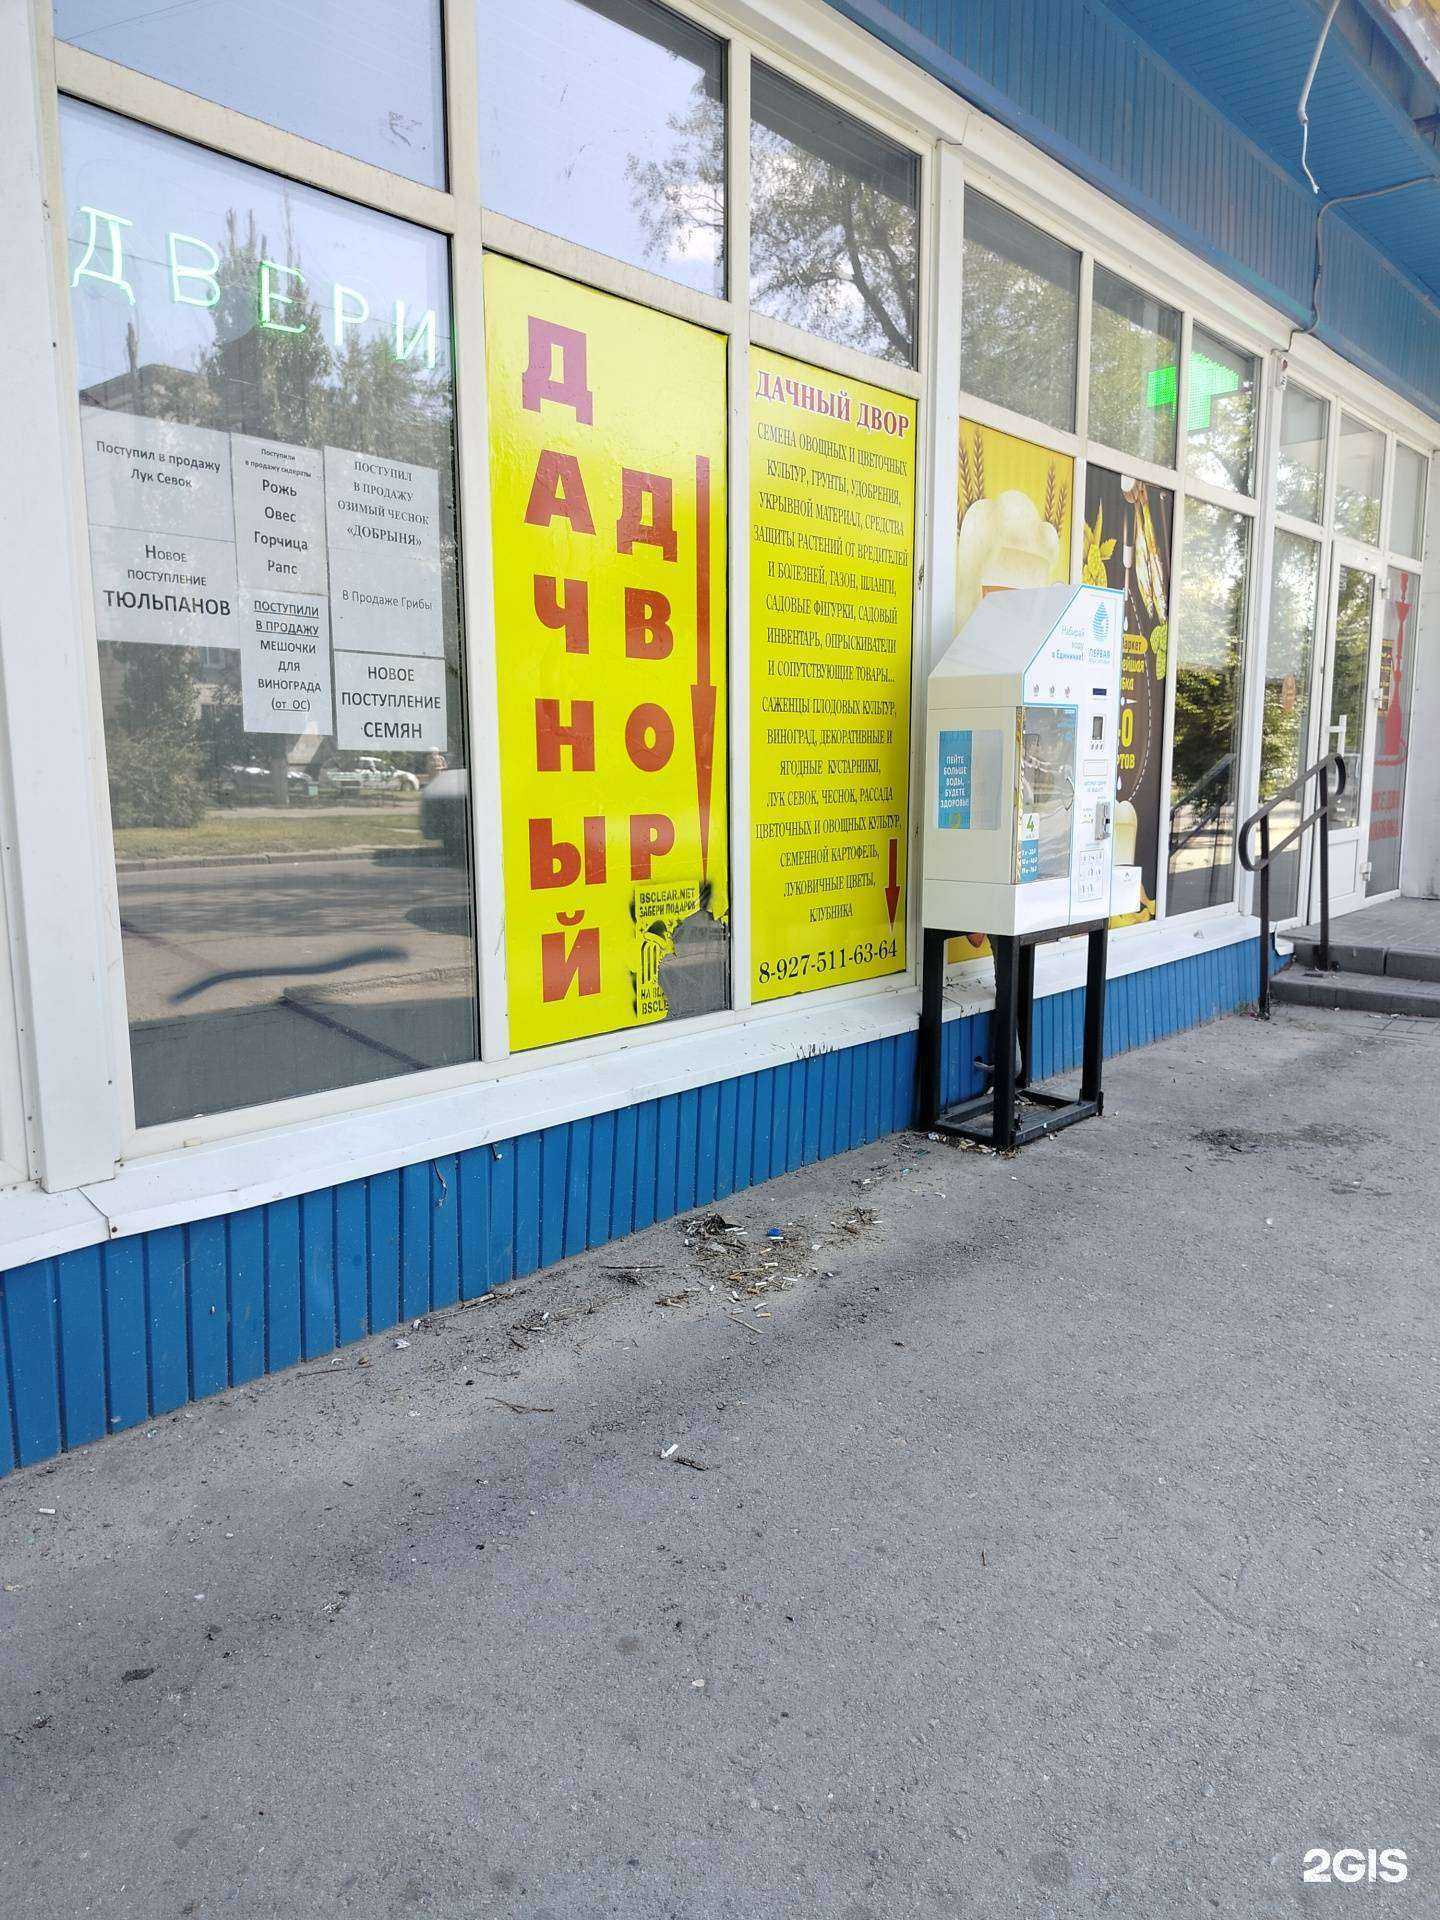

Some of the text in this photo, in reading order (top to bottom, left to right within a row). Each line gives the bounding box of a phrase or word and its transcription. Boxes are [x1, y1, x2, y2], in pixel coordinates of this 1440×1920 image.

[69, 205, 437, 369] ДВЕРИ
[756, 370, 908, 438] ДАЧНЫЙ ДВОР
[96, 440, 220, 473] Поступил в продажу
[758, 422, 907, 476] СЕМЕНА ОВОЩНЫХ И ЦВЕТОЧНЫХ
[131, 469, 192, 488] Лук Севок
[354, 461, 412, 482] ПОСТУПИЛ
[262, 479, 297, 496] Рожь
[354, 482, 414, 502] В ПРОДАЖУ
[768, 459, 902, 506] КУЛЬТУР, ГРУНТЫ, УДОБРЕНИЯ,
[264, 506, 296, 523] Овес
[338, 500, 430, 525] ОЗИМЫЙ ЧЕСНОК
[760, 492, 904, 536] УКРЫВНОЙ МАТЕРИАЛ, СРЕДСТВА
[254, 531, 308, 550] Горчица
[347, 524, 422, 546] «ДОБРЫНЯ»
[754, 525, 908, 567] ЗАЩИТЫ РАСТЕНИЙ ОТ ВРЕДИТЕЛЕЙ
[268, 560, 298, 575] Рапс
[768, 561, 896, 596] И БОЛЕЗНЕЙ, ГАЗОН, ШЛАНГИ,
[104, 590, 231, 616] ТЮЛЬПАНОВ
[254, 600, 320, 616] ПОСТУПИЛИ
[342, 590, 432, 610] В Продаже Грибы
[766, 594, 898, 625] САДОВЫЕ ФИГУРКИ, САДОВЫЙ
[256, 620, 320, 636] В ПРОДАЖУ
[260, 640, 316, 654] МЕШОЧКИ
[768, 628, 896, 654] ИНВЕНТАРЬ, ОПРЫСКИВАТЕЛИ
[278, 660, 300, 673] ДЛЯ
[522, 315, 608, 1004] ДАЧНЫЙ
[368, 667, 414, 682] НОВОЕ
[617, 467, 678, 882] ДВОР
[768, 660, 774, 676] И
[778, 660, 854, 682] СОПУТСТВУЮЩИЕ
[258, 678, 322, 693] ВИНОГРАДА
[292, 698, 310, 712] ОС)
[342, 692, 441, 710] ПОСТУПЛЕНИЕ
[762, 697, 897, 718] САЖЕНЦЫ ПЛОДОВЫХ КУЛЬТУР,
[363, 721, 422, 739] СЕМЯН
[768, 728, 893, 747] ВИНОГРАД, ДЕКОРАТИВНЫЕ И
[780, 758, 881, 777] ЯГОДНЫЕ КУСТАРНИКИ,
[766, 786, 894, 807] ЛУК СЕВОК, ЧЕСНОК, РАССАДА
[756, 814, 902, 841] ЦВЕТОЧНЫХ И ОВОЩНЫХ КУЛЬТУР,
[1026, 815, 1034, 832] 4
[780, 844, 880, 868] СЕМЕННОЙ КАРТОФЕЛЬ,
[784, 872, 876, 898] ЛУКОВИЧНЫЕ ЦВЕТЫ,
[640, 888, 696, 904] BSCLEAR.NET
[640, 904, 665, 918] ЗАБЕРИ
[808, 903, 854, 922] КЛУБНИКА
[758, 938, 898, 984] 8-927-511-63-64
